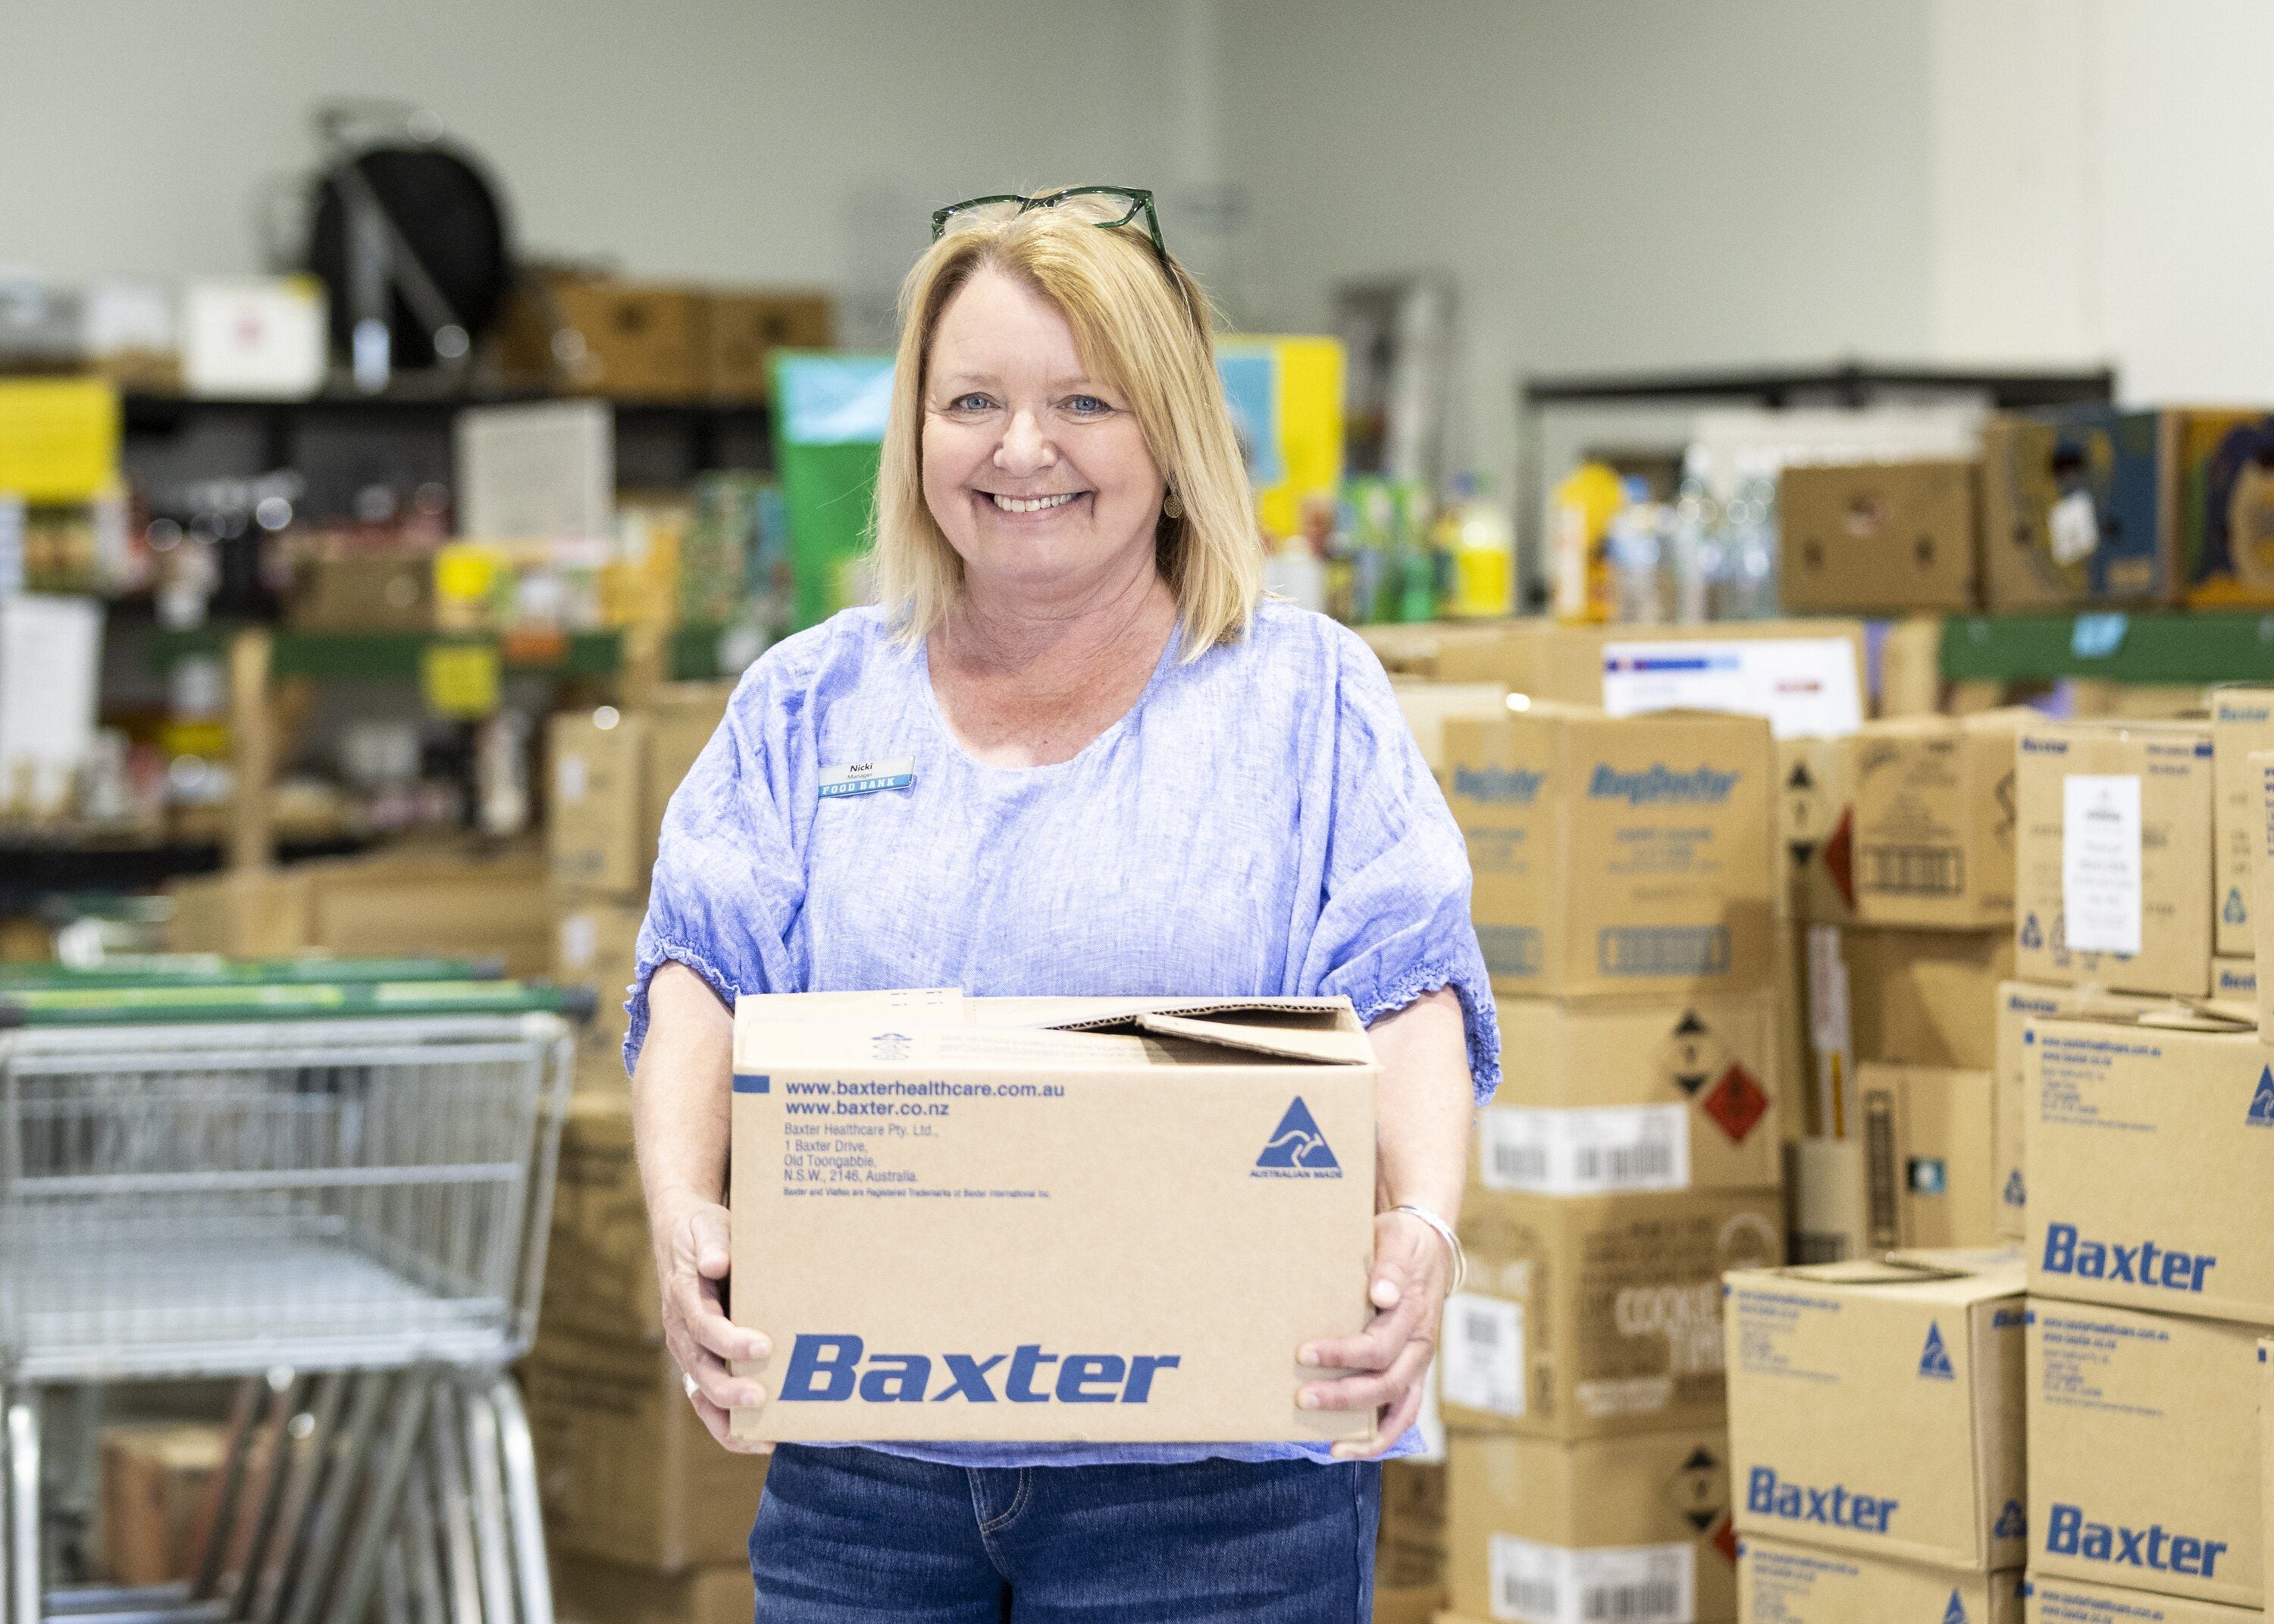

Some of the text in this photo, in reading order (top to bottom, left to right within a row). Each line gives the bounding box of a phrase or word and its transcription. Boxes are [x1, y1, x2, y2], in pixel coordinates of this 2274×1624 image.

[850, 763, 873, 772] Nicki
[822, 778, 894, 794] FOOD BANK
[786, 1080, 1064, 1097] www.baxterhealthcare.com.au
[786, 1101, 950, 1116] www.baxter.co.nz
[785, 1122, 819, 1134] Baxter
[824, 1123, 884, 1135] Healthcare
[888, 1123, 908, 1137] Pty.
[785, 1140, 868, 1153] 1 Baxter Drive,
[784, 1154, 803, 1166] Old
[784, 1169, 825, 1182] N.S.W.,
[830, 1170, 862, 1182] 2146,
[1250, 1169, 1343, 1178] AUSTRALIAN MADE
[784, 1187, 807, 1196] Baxter
[810, 1187, 823, 1196] and
[866, 1187, 906, 1197] Registered
[909, 1187, 951, 1197] Trademarks
[963, 1188, 985, 1198] Baxter
[990, 1189, 1035, 1198] International
[2042, 1221, 2216, 1293] Baxter
[777, 1334, 1181, 1403] Baxter
[1747, 1465, 1900, 1535] Baxter
[2047, 1502, 2228, 1579] Baxter
